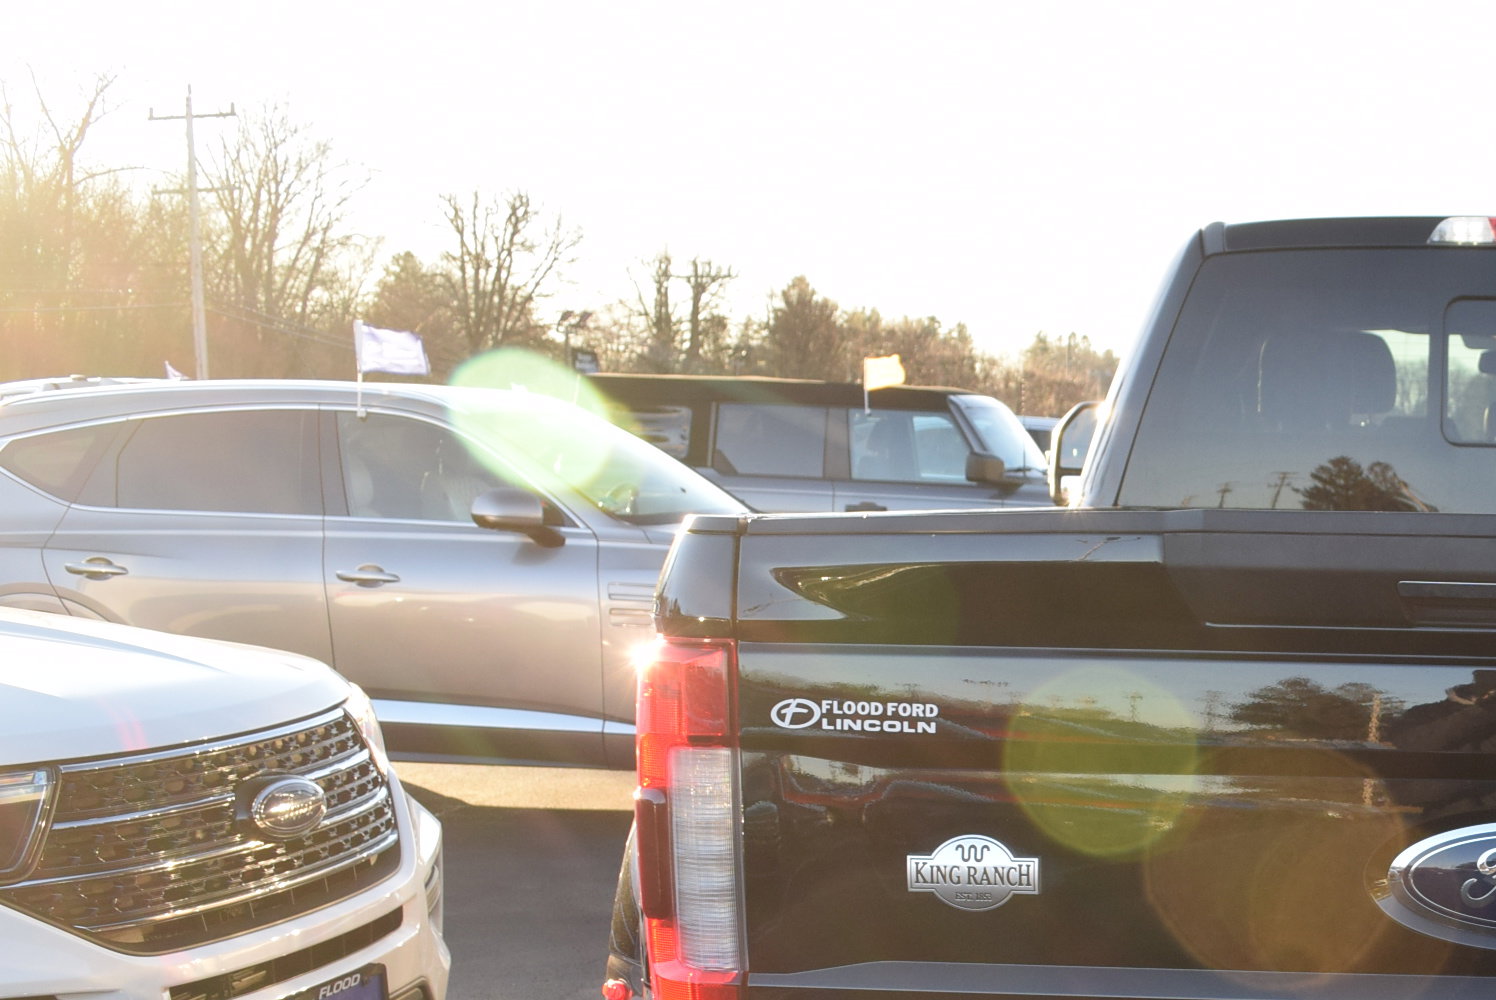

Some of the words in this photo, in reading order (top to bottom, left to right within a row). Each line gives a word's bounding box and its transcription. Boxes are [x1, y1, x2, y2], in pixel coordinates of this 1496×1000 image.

[821, 700, 884, 716] FLOOD
[886, 702, 939, 718] FORD
[821, 718, 937, 734] LINCOLN
[914, 861, 961, 885] KING
[966, 864, 1033, 887] RANCH
[318, 973, 361, 1000] FLOOD
